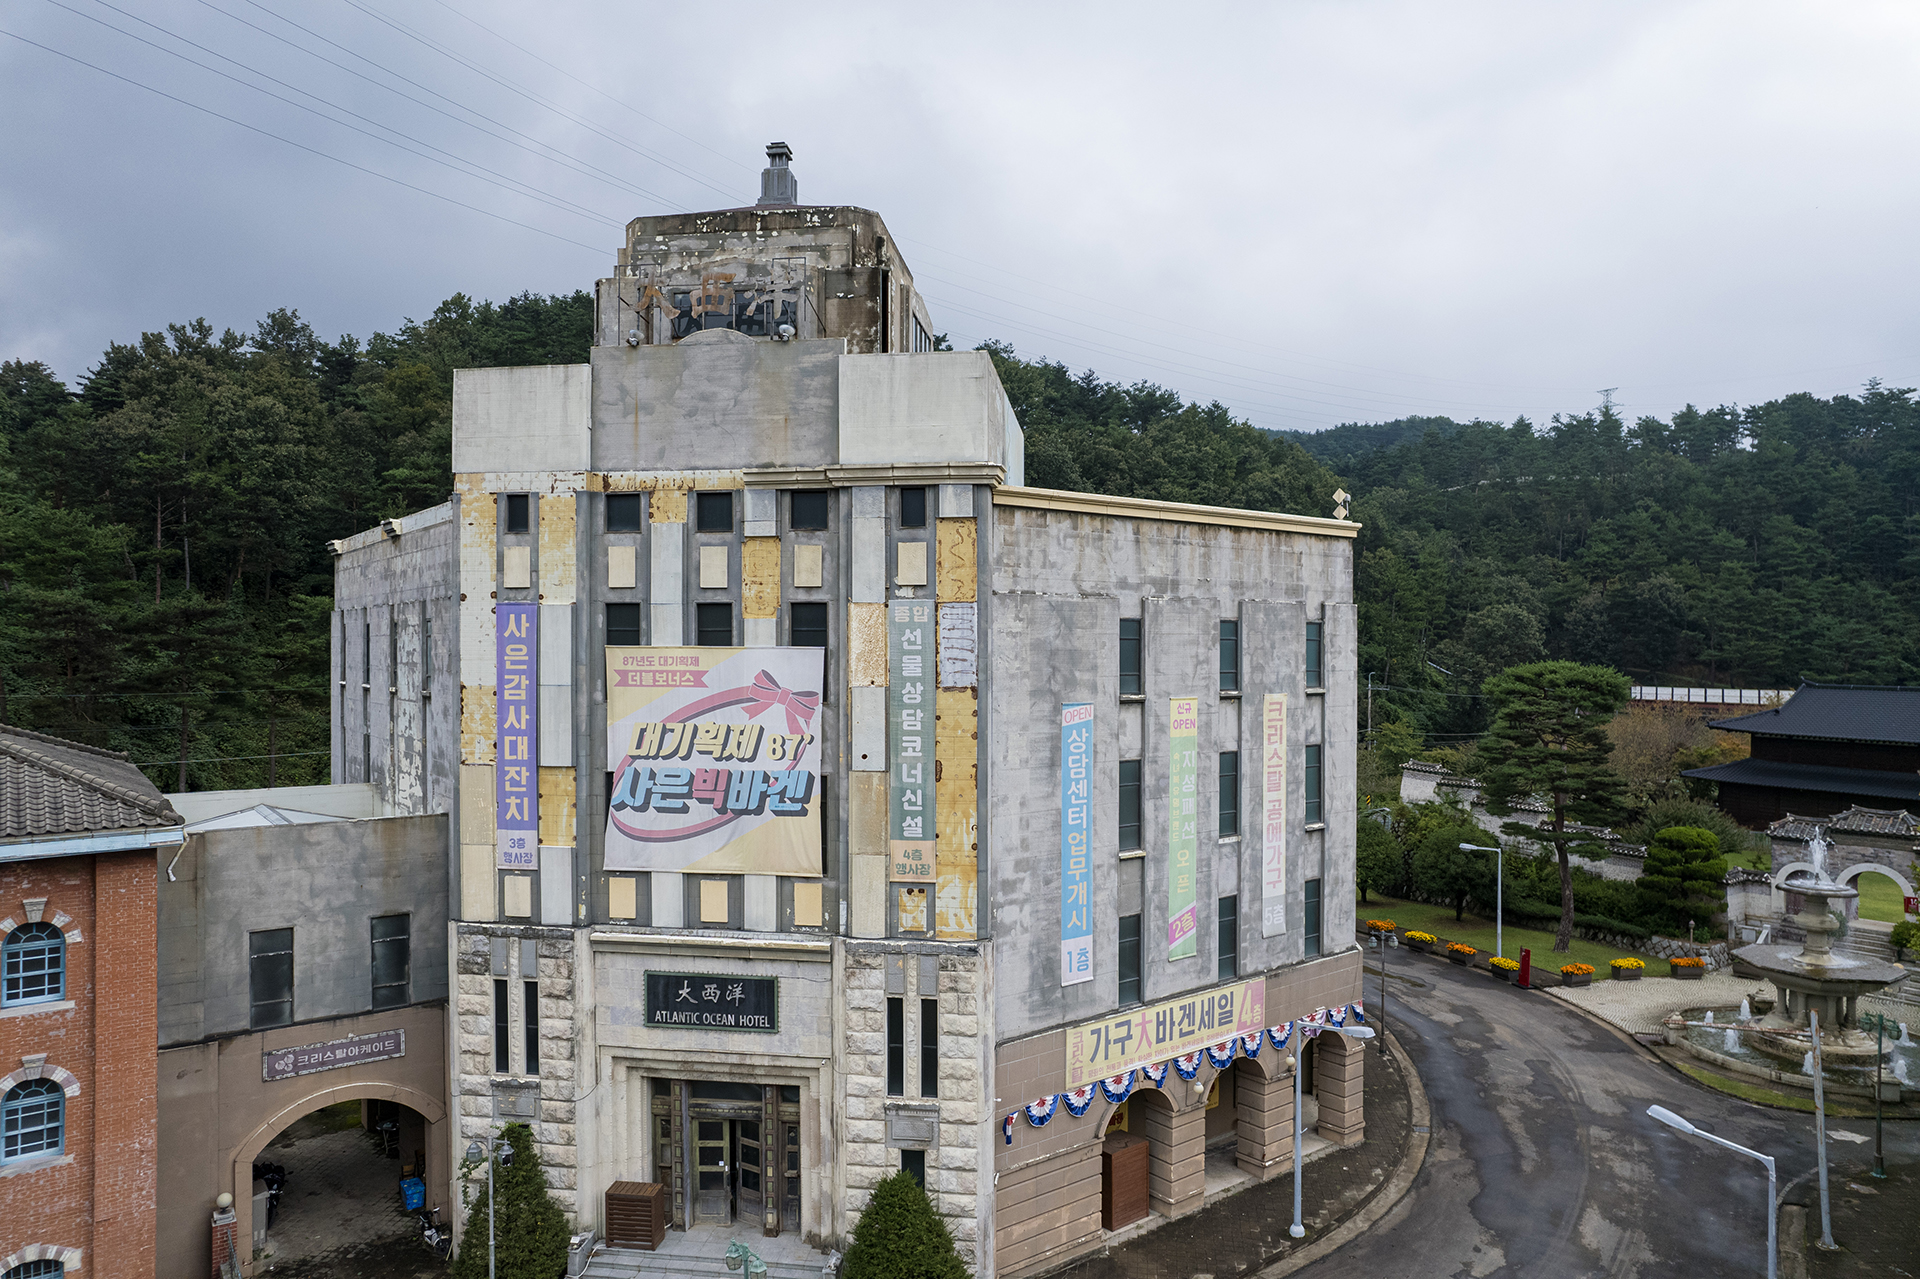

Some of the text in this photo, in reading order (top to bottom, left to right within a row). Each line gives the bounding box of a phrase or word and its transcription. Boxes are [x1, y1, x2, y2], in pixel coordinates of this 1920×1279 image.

[894, 605, 930, 623] 종합
[622, 655, 700, 668] 87년도 대기획제
[628, 671, 695, 686] 더블보너스
[1064, 705, 1092, 724] OPEN
[1176, 702, 1192, 715] 신규
[1172, 718, 1196, 730] OPEN
[627, 722, 765, 763] 대기획제
[509, 837, 526, 849] 3층
[503, 851, 533, 864] 행사장
[902, 848, 923, 861] 4층
[895, 863, 932, 876] 행사장
[1176, 849, 1190, 894] 오픈
[1264, 904, 1284, 926] 5층
[1172, 912, 1194, 939] 2층
[1067, 947, 1089, 973] 1층
[675, 980, 745, 1007] 大西洋
[654, 1010, 770, 1028] ATLANTIC OCEAN HOTEL
[1071, 1031, 1084, 1084] 크리스탈
